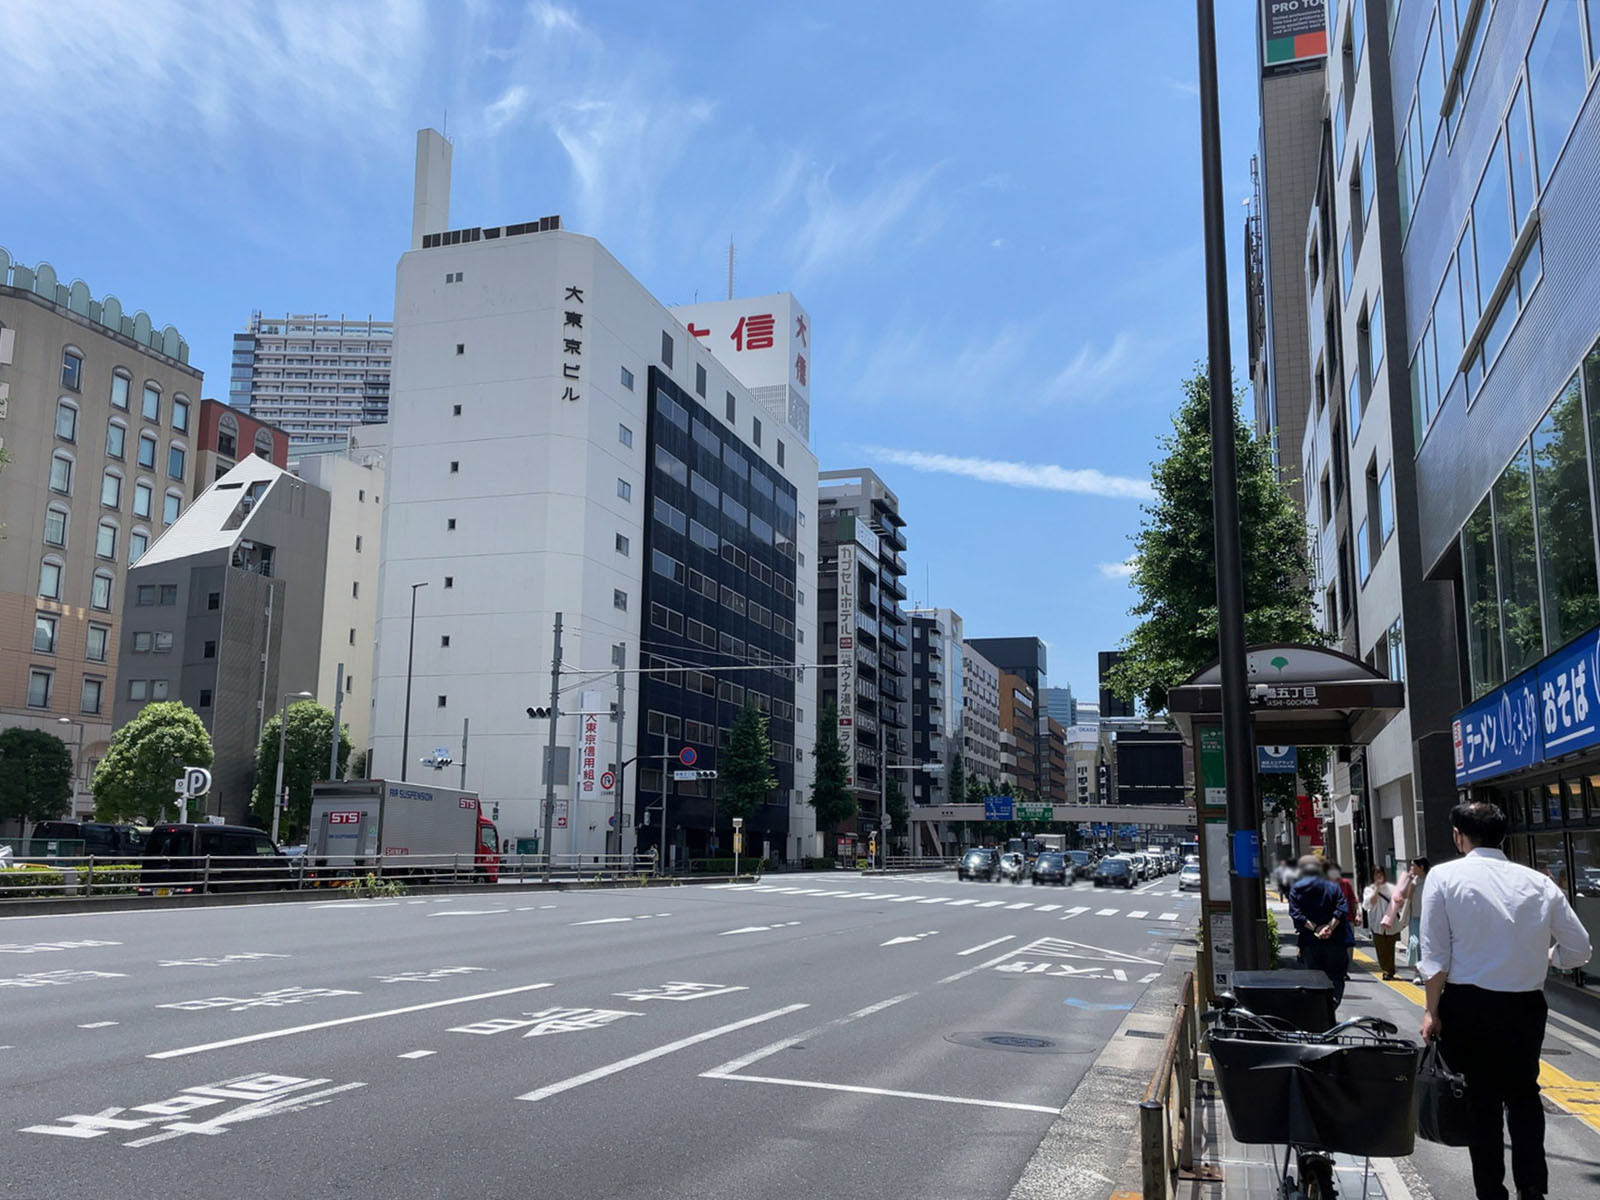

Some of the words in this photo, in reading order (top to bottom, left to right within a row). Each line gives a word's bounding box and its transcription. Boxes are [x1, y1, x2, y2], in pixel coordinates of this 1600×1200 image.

[1272, 1, 1298, 13] PRO
[562, 285, 584, 402] 大東京ビル
[795, 314, 807, 387] 大信
[840, 546, 852, 635] カプセルホテル
[1543, 659, 1588, 734] おそば
[582, 713, 598, 792] 大東京信用組合
[1466, 712, 1496, 763] ラーメン
[331, 812, 359, 823] STS
[400, 789, 433, 802] SUSPENSION
[460, 798, 476, 809] STS
